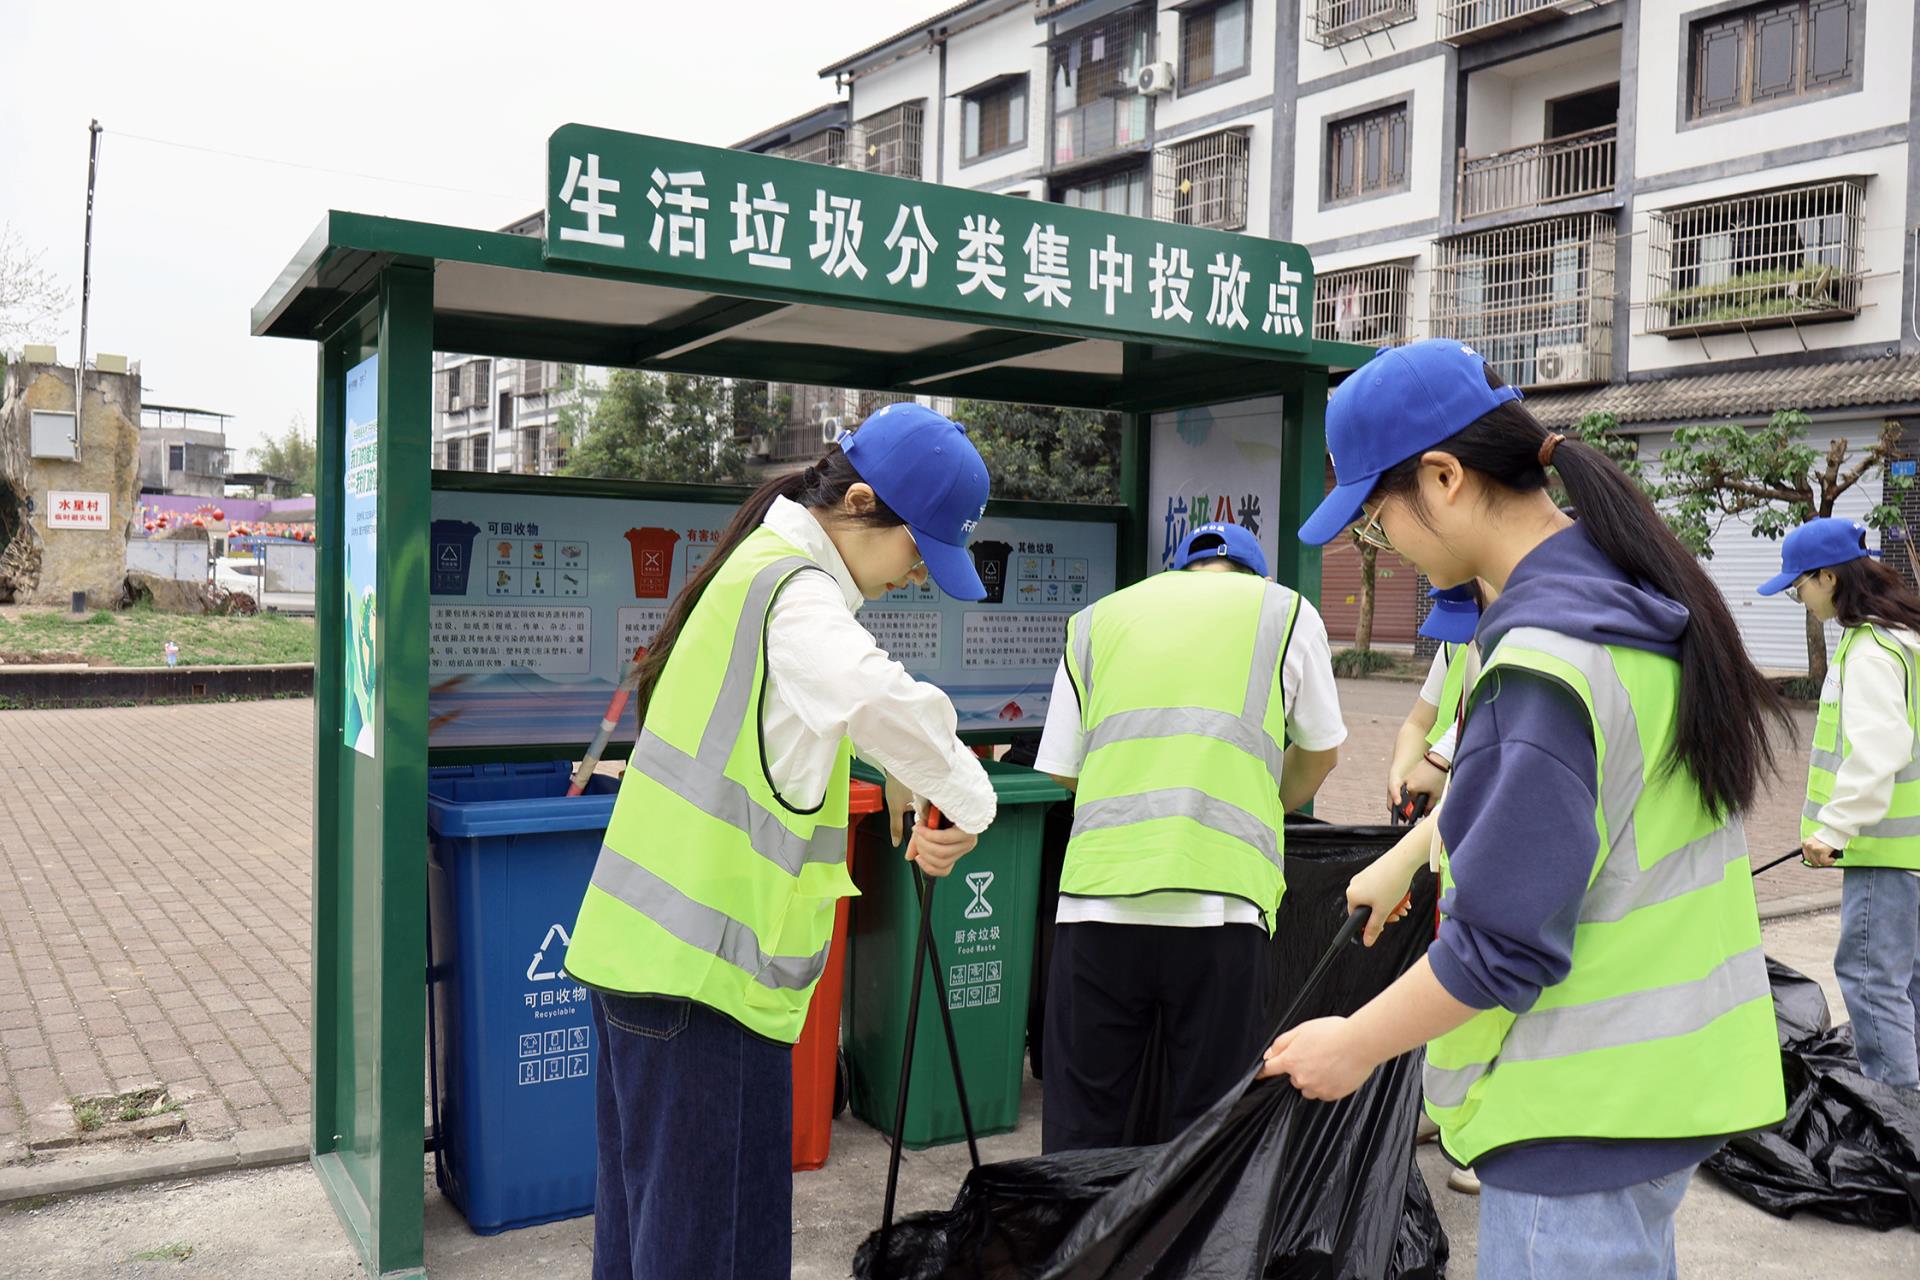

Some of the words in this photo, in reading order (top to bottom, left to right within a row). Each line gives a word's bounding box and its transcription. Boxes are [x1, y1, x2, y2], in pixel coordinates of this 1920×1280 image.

[558, 154, 1304, 337] 生活垃圾分类集中投放点
[58, 499, 98, 511] 水星村
[487, 521, 539, 536] 可回收物
[687, 529, 723, 542] 有害垃
[1018, 542, 1054, 554] 其他垃圾
[954, 926, 1000, 944] 厨余垃圾
[958, 945, 974, 955] Food
[976, 944, 996, 953] Waste
[523, 986, 587, 1009] 可回收物
[534, 1007, 576, 1019] Recyclable
